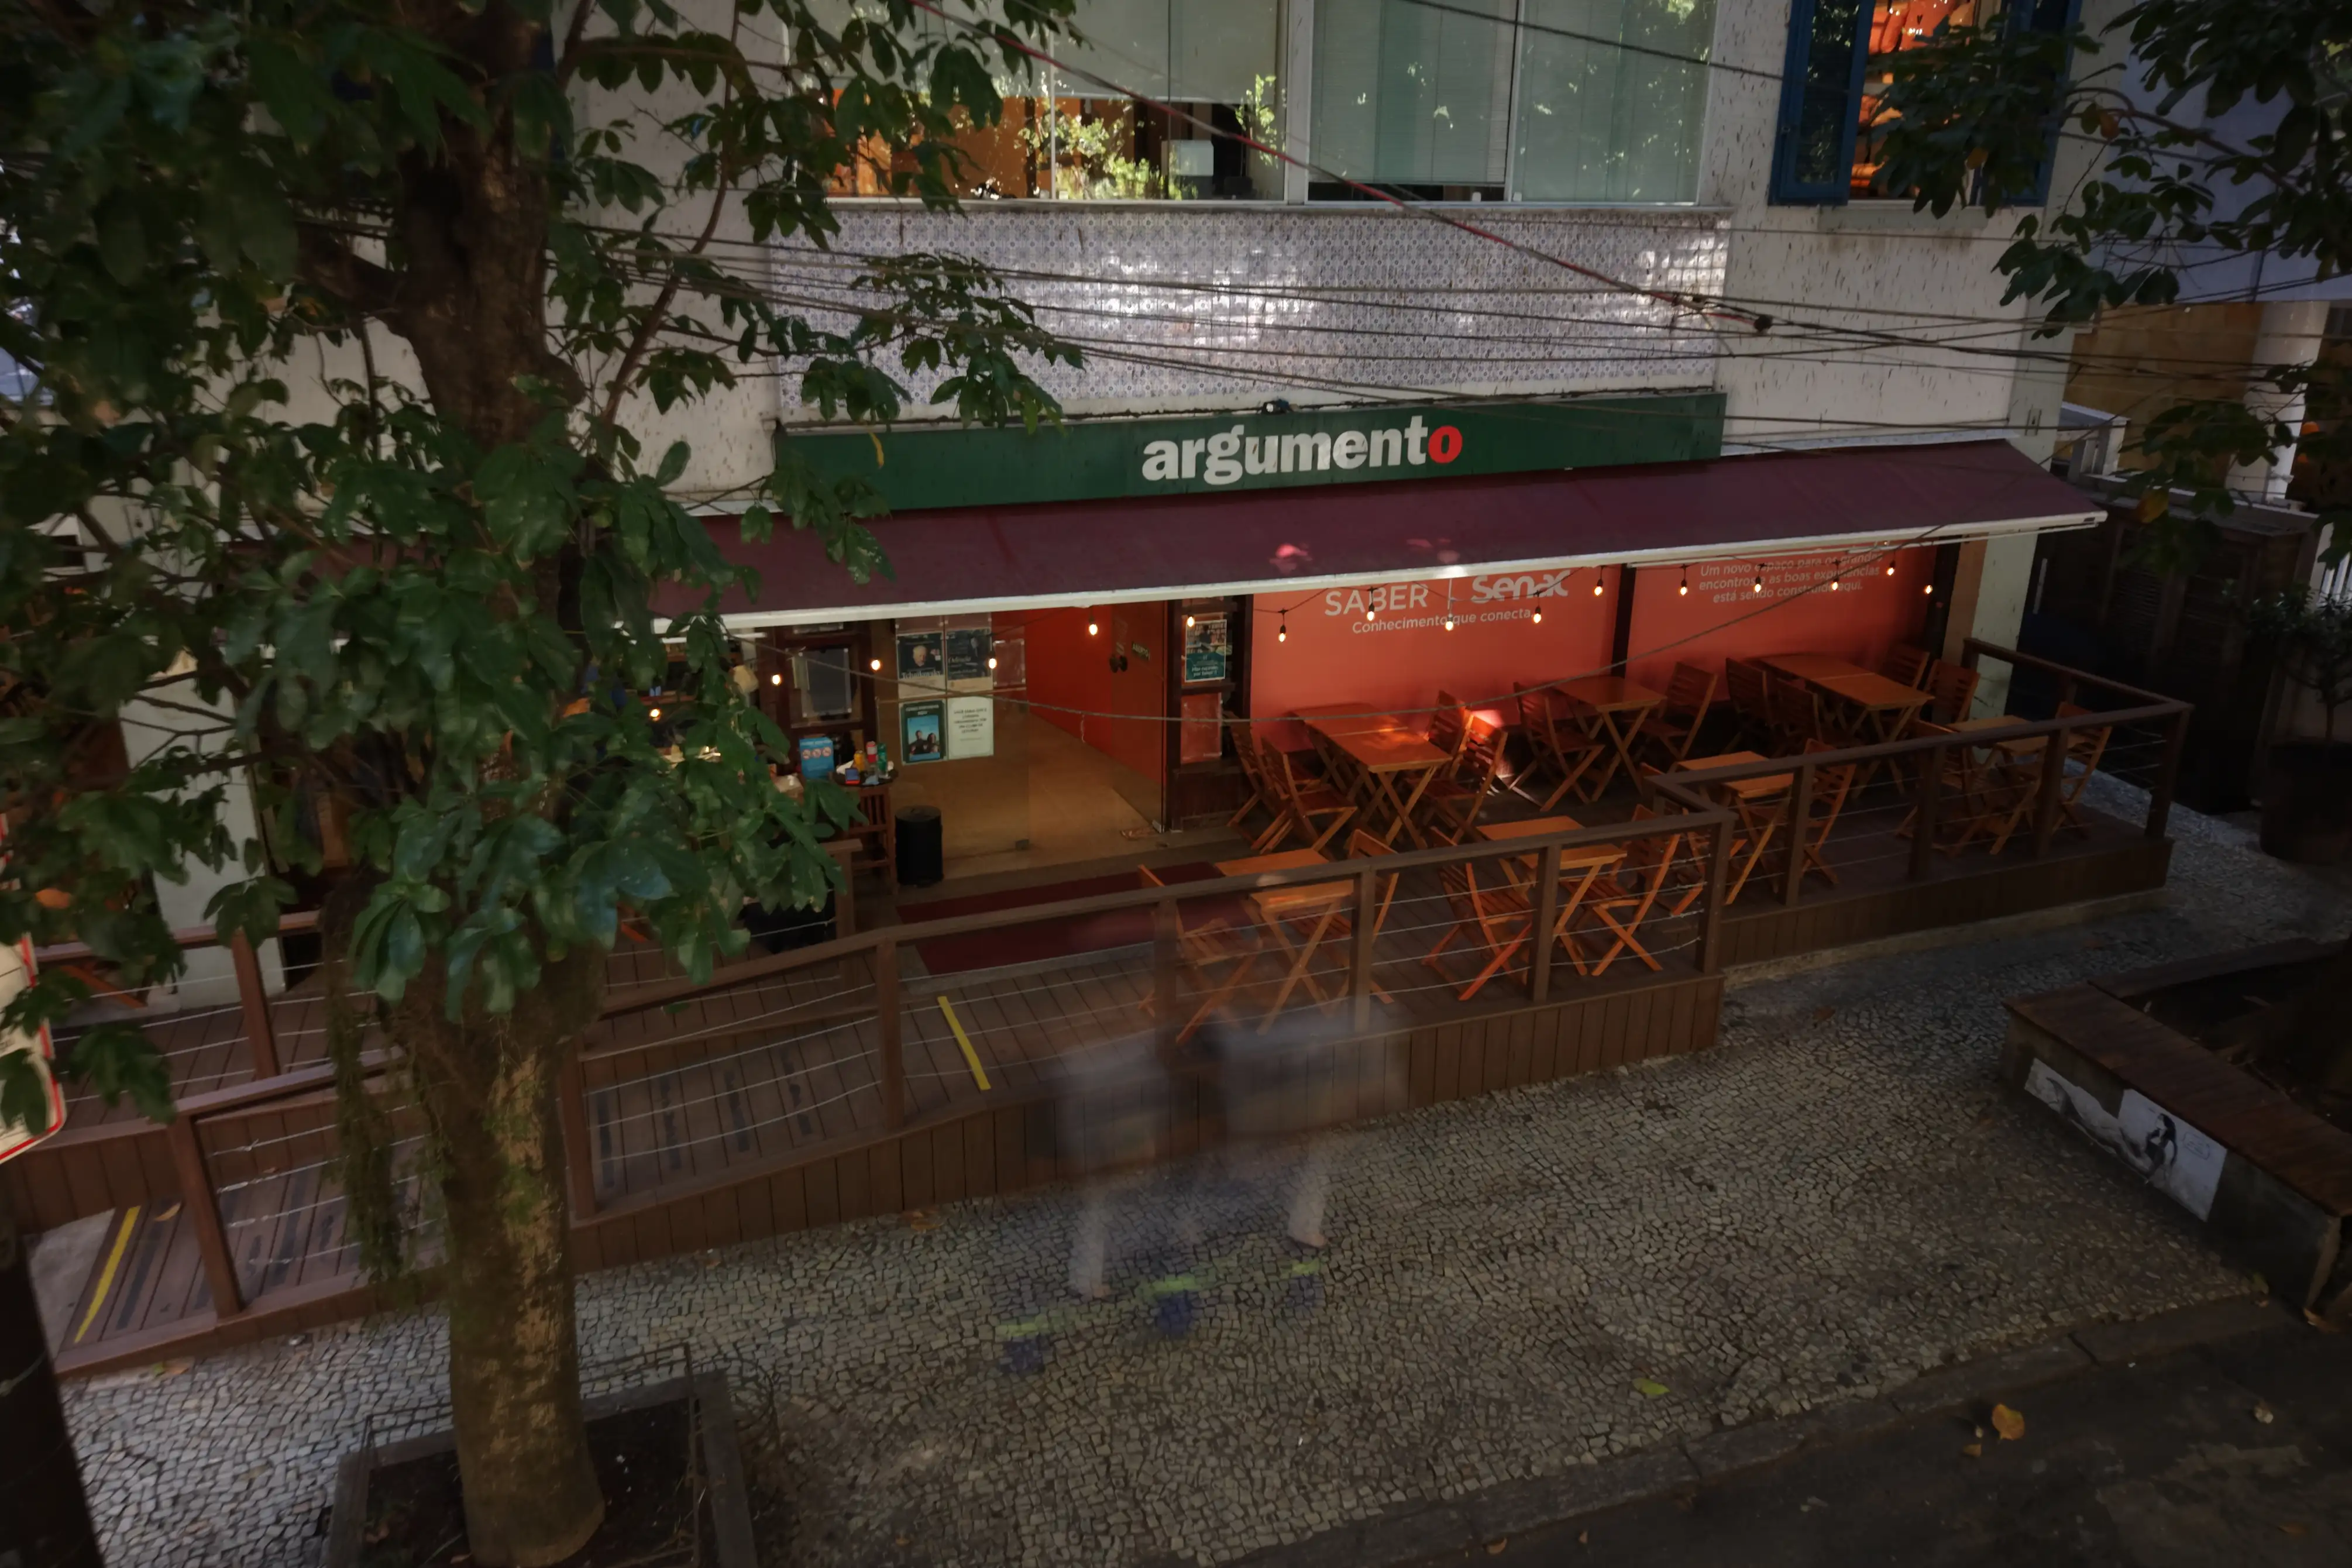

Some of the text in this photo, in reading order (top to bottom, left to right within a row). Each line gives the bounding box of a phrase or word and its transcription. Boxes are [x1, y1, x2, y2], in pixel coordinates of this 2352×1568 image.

[1142, 415, 1463, 485] argumento
[1701, 565, 1720, 576] Um
[1724, 563, 1751, 575] novo
[1797, 558, 1821, 570] para
[1699, 576, 1755, 590] encontros
[1769, 574, 1781, 584] as
[1784, 570, 1811, 583] boas
[1324, 584, 1429, 617] SABER
[1713, 589, 1737, 603] está
[1352, 616, 1449, 634] Conhecimento
[1454, 614, 1477, 627] que
